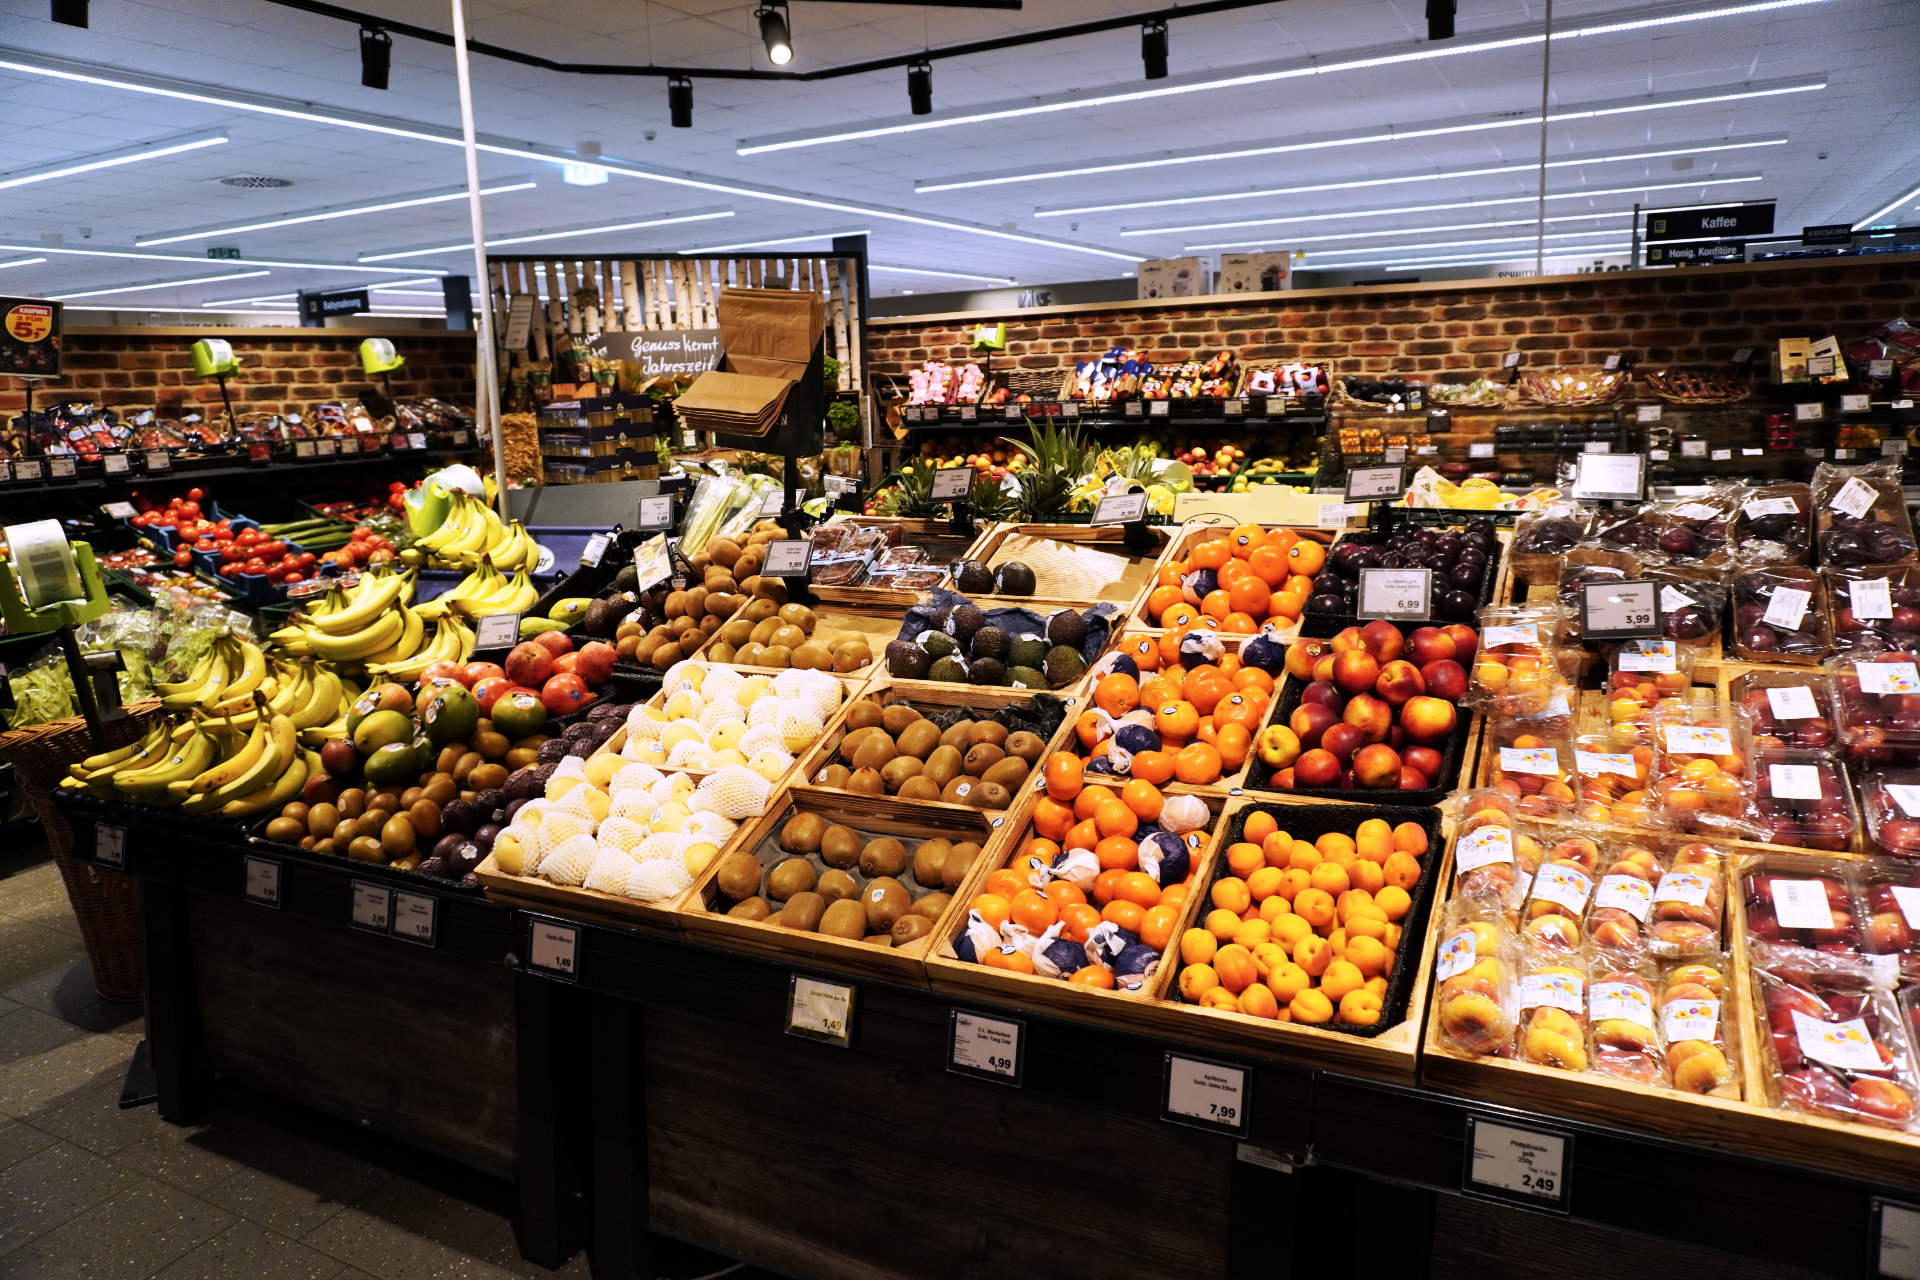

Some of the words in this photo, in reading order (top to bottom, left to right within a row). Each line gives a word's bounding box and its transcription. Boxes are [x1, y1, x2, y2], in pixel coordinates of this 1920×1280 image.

[1702, 217, 1737, 229] Kaffee
[1669, 249, 1696, 259] Honig,
[1698, 247, 1737, 257] Konfitüre
[323, 299, 361, 310] Babynahrung
[631, 336, 681, 357] Genuss
[682, 334, 719, 352] kennt
[642, 355, 714, 375] Jahreszeit
[1398, 600, 1420, 609] 6,99
[1625, 614, 1650, 624] 3,99
[823, 1018, 842, 1031] 1,49
[988, 1055, 1011, 1070] 4,99
[1210, 1103, 1236, 1119] 7,99
[1521, 1174, 1554, 1191] 2,49
